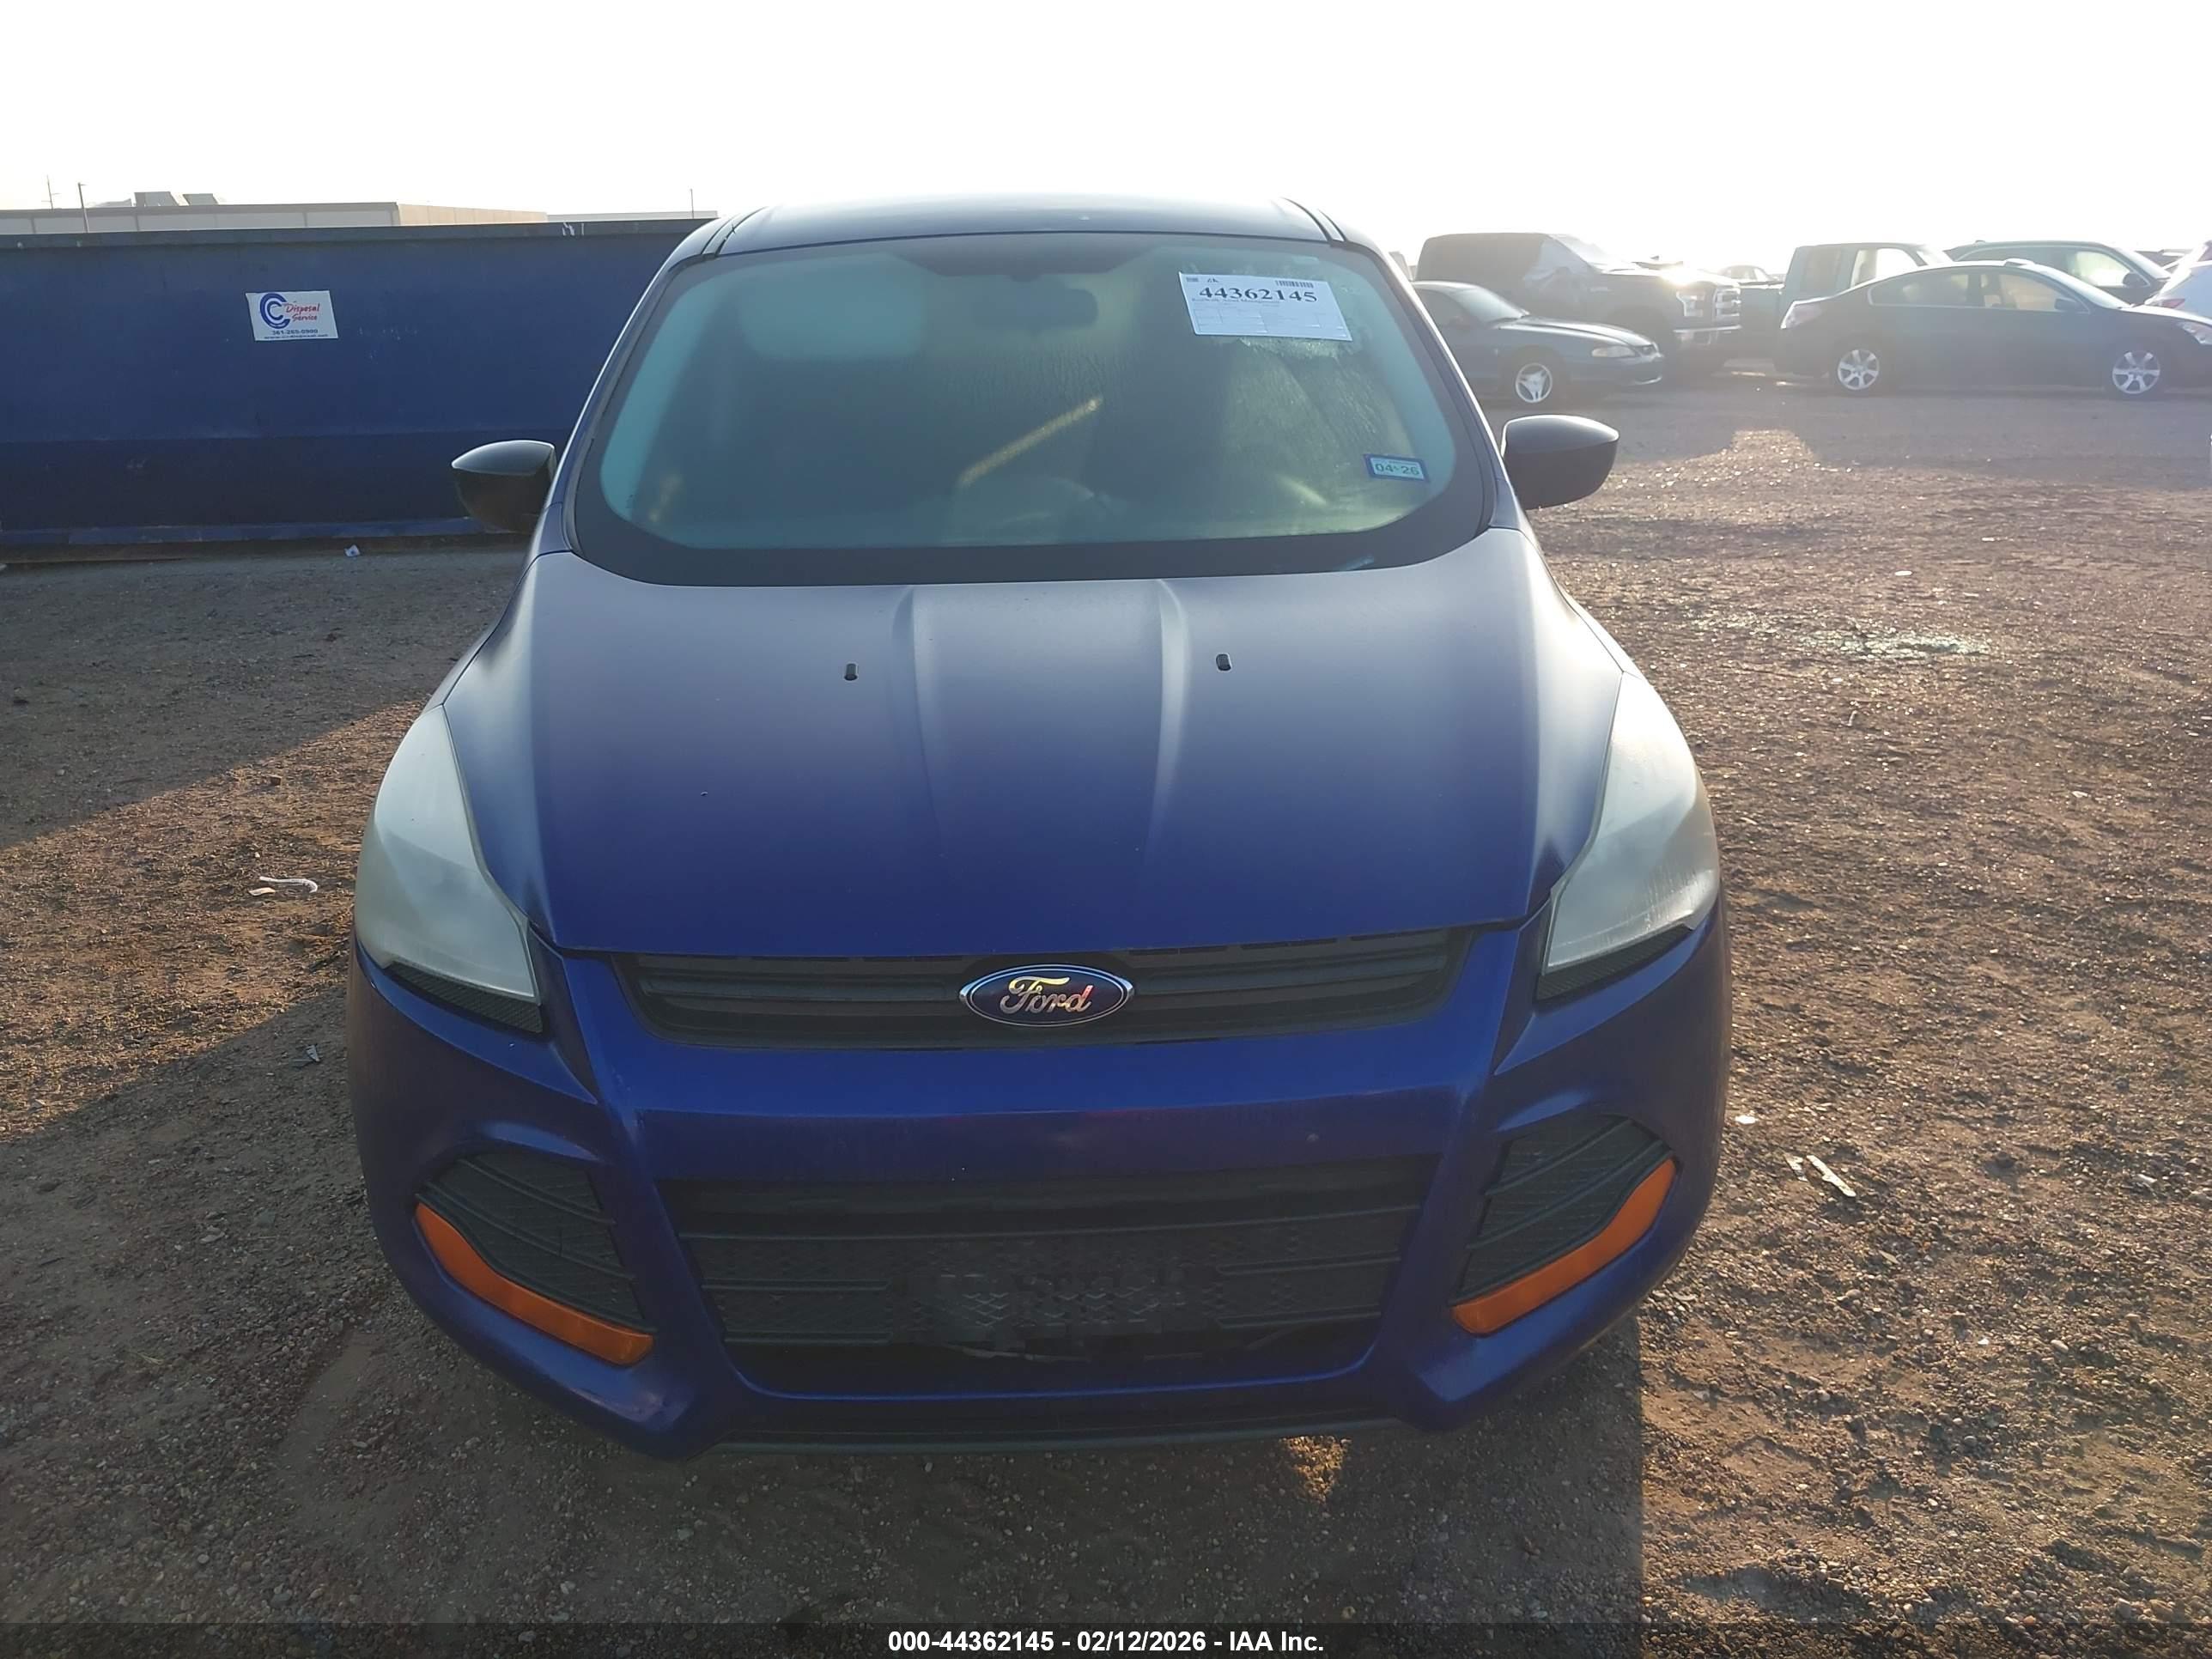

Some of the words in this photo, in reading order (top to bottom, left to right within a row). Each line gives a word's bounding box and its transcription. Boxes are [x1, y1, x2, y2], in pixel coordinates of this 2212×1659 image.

[1199, 287, 1318, 302] 44362145
[286, 303, 320, 314] Disposal
[292, 313, 317, 322] Service
[1000, 975, 1094, 1014] Ford
